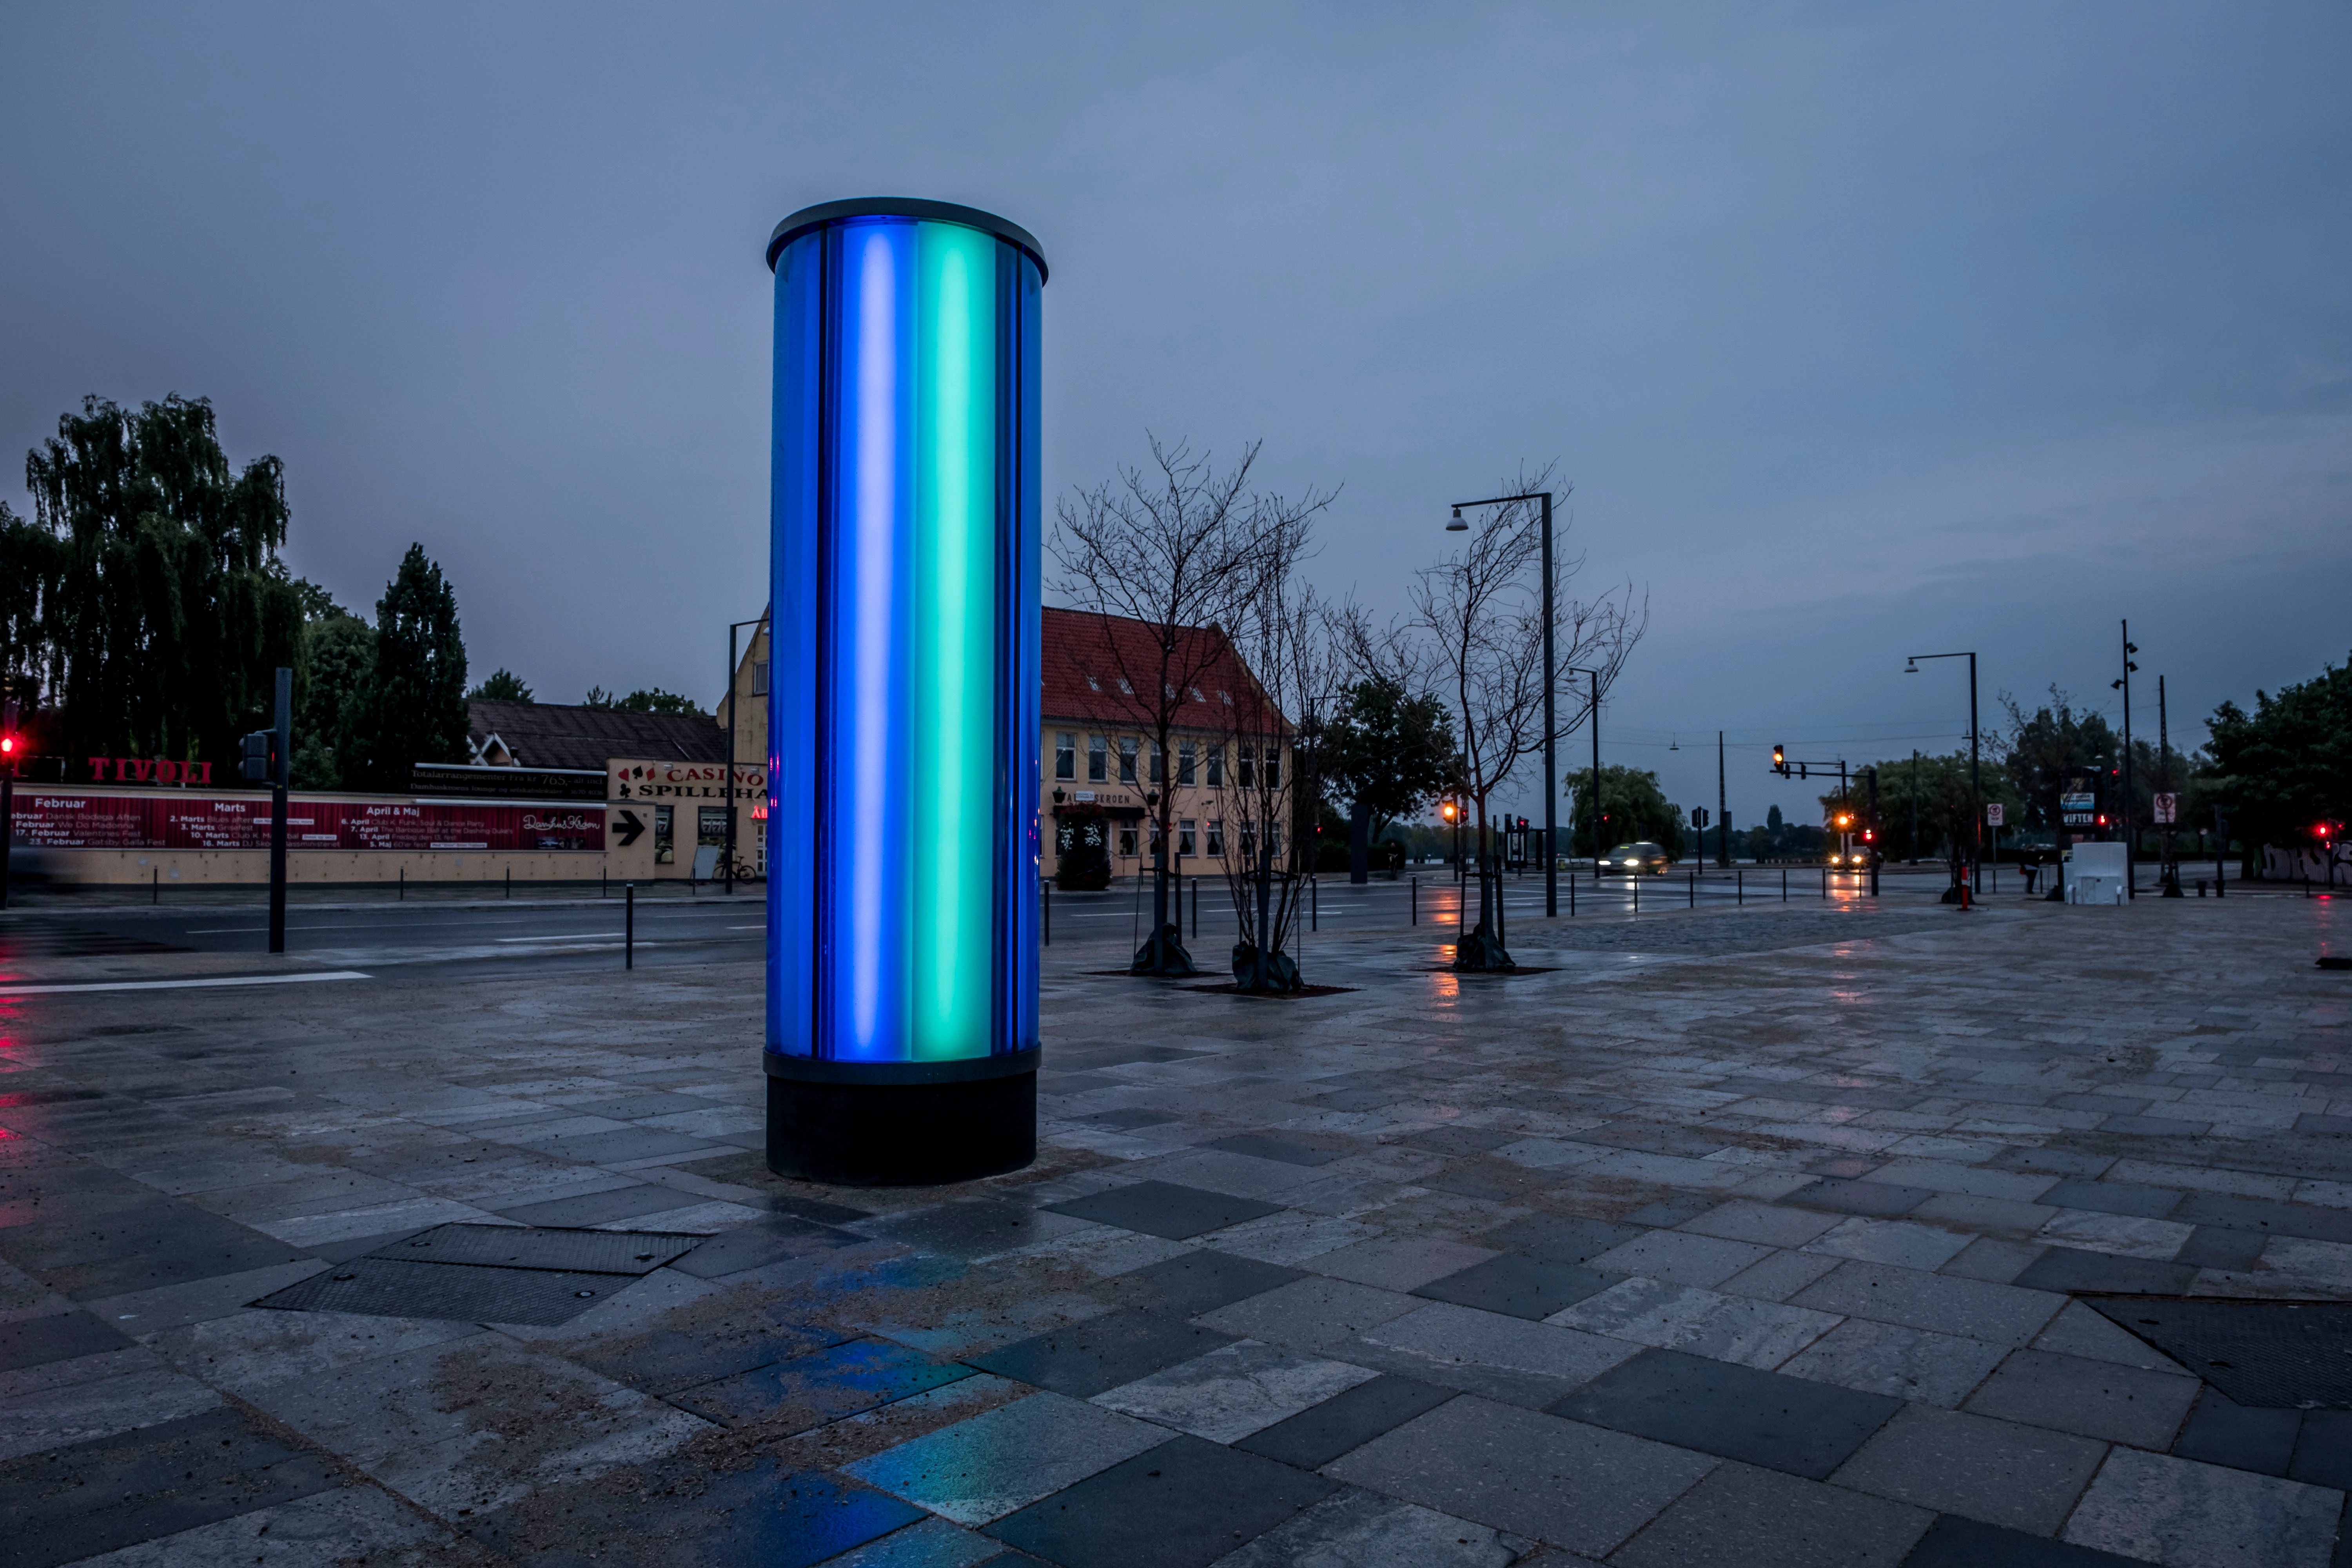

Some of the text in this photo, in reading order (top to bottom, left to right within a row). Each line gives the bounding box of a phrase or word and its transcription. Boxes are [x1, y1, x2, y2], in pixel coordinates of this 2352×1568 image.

[88, 757, 212, 784] TIVOLI
[411, 769, 506, 781] Totalarrangementer
[667, 768, 764, 786] CASINO
[35, 798, 86, 808] Februar
[214, 802, 246, 812] Marts
[367, 806, 420, 817] April & Maj
